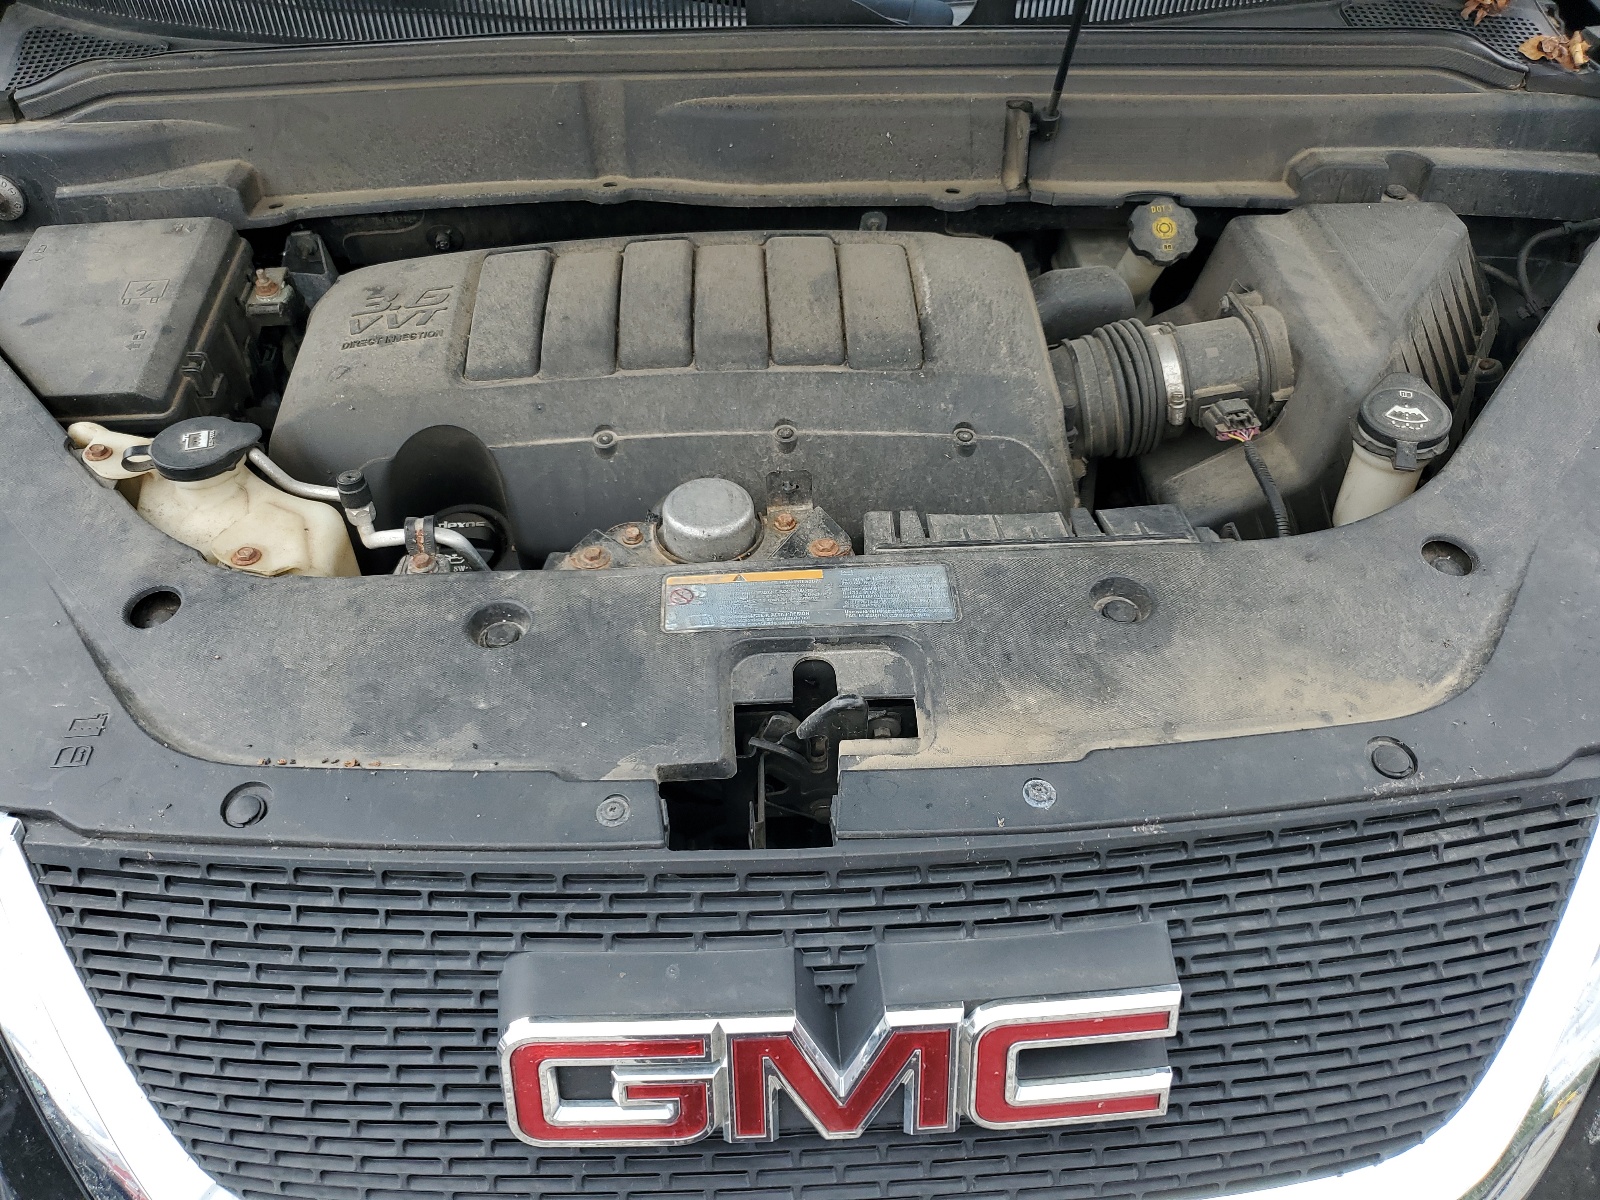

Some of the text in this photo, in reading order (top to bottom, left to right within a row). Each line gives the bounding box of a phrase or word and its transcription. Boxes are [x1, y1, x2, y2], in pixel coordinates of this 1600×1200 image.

[1151, 205, 1164, 213] DOT
[351, 284, 454, 317] 3.6
[348, 306, 449, 336] VVT
[341, 329, 444, 351] DIRECT INJECTION
[499, 984, 1182, 1148] GMC
